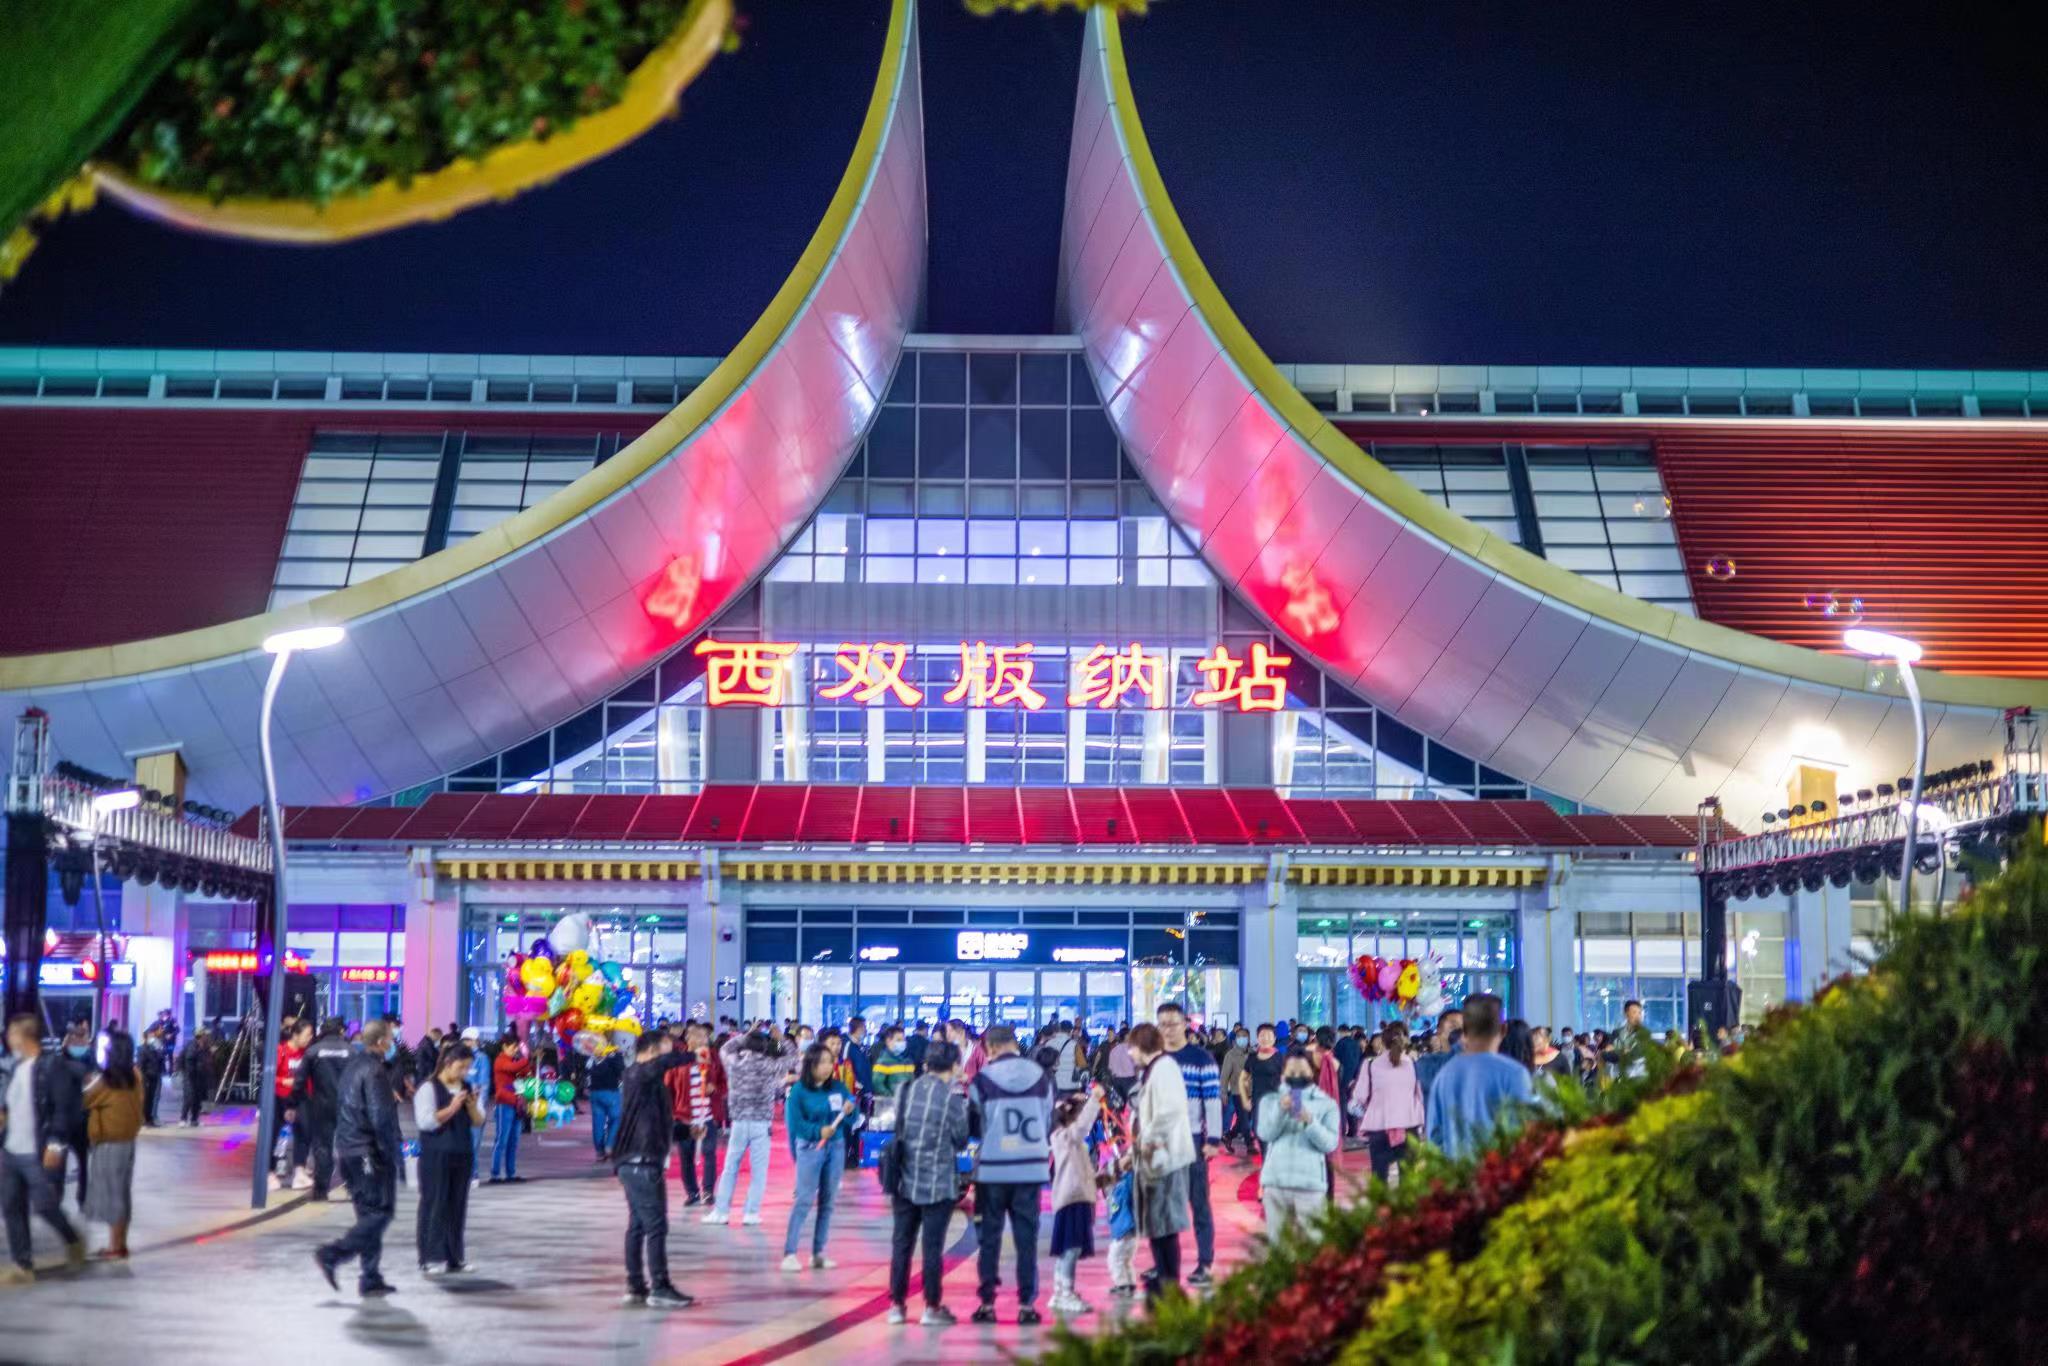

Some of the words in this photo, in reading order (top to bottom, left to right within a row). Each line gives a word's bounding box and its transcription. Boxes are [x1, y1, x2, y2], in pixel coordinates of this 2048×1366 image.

[694, 639, 1292, 712] 西双版纳站
[1005, 1108, 1041, 1143] DC
